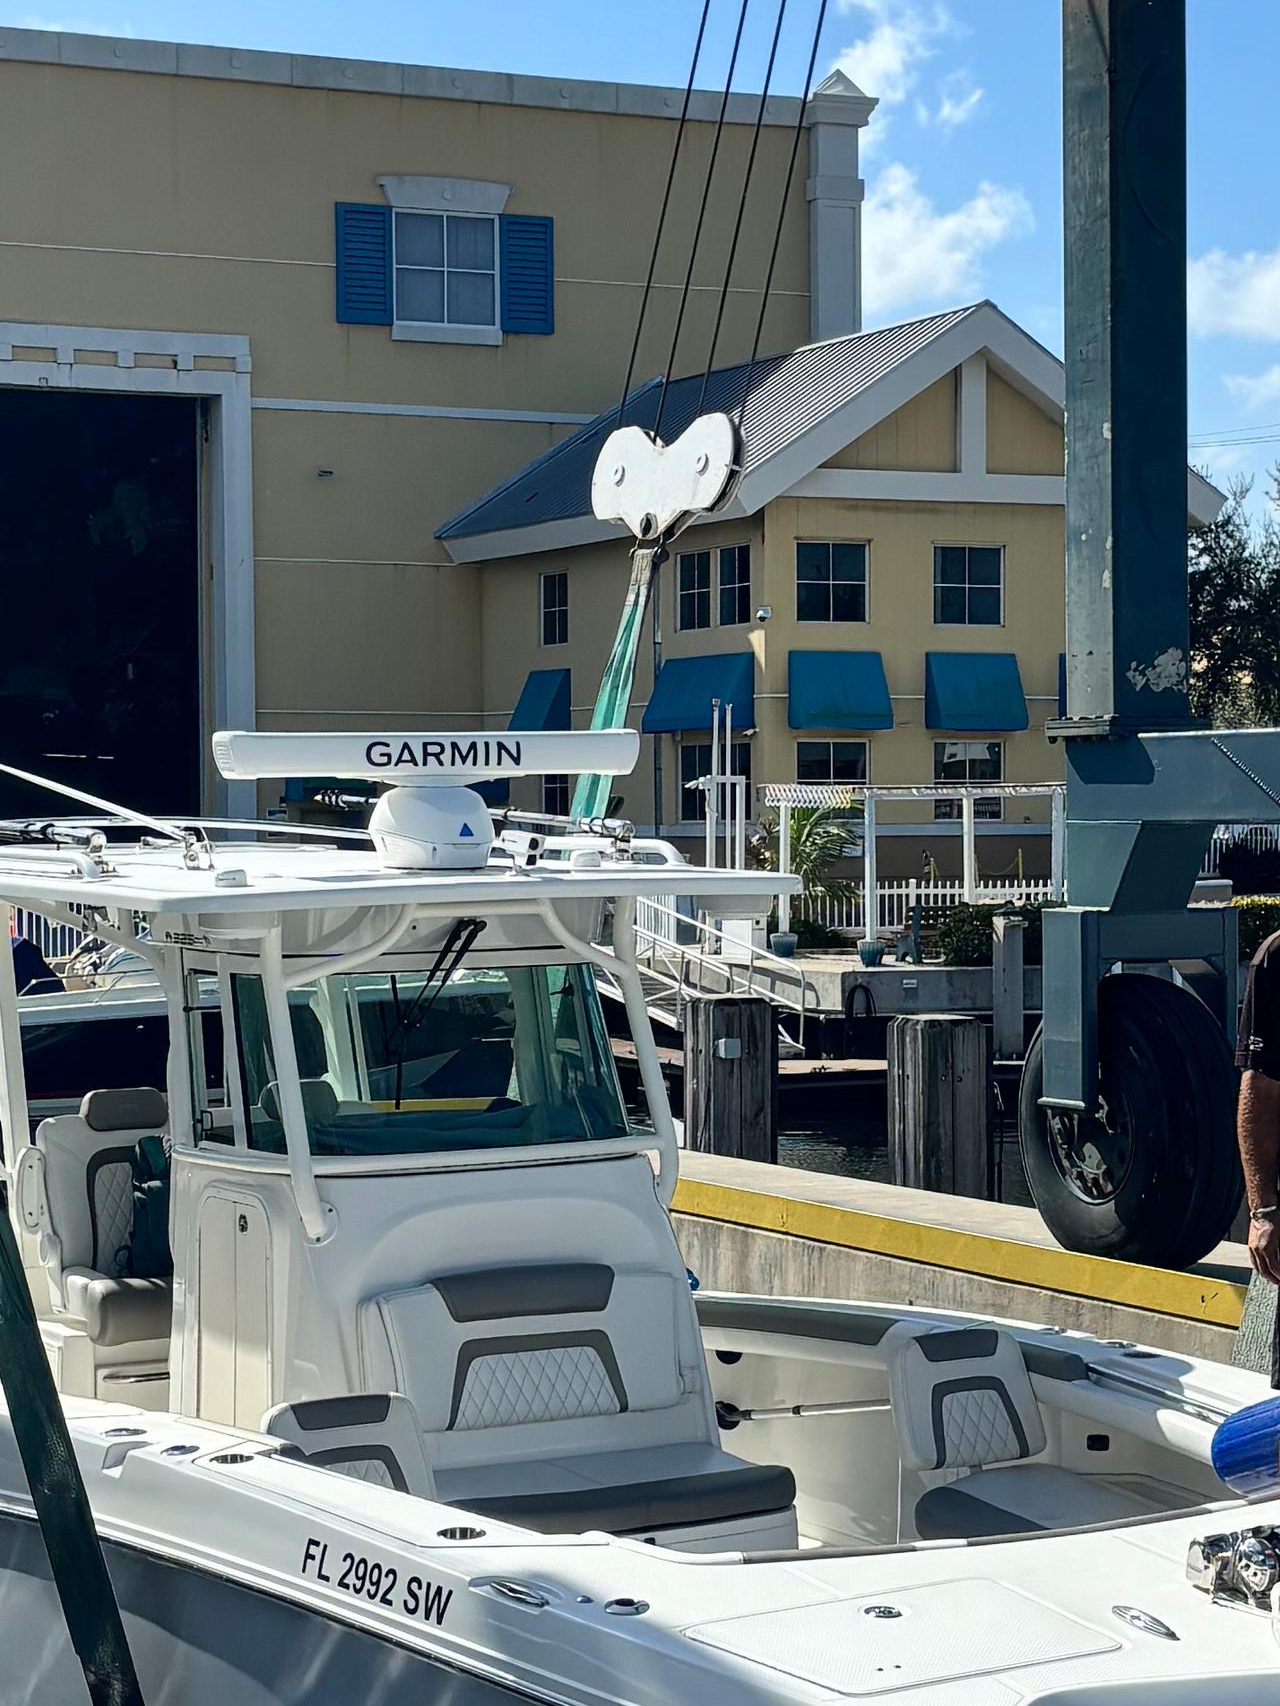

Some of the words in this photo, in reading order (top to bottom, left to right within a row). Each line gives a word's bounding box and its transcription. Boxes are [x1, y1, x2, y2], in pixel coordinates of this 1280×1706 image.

[365, 740, 522, 767] GARMIN
[301, 1537, 331, 1583] FL
[337, 1552, 398, 1607] 2992
[403, 1576, 454, 1626] SW
